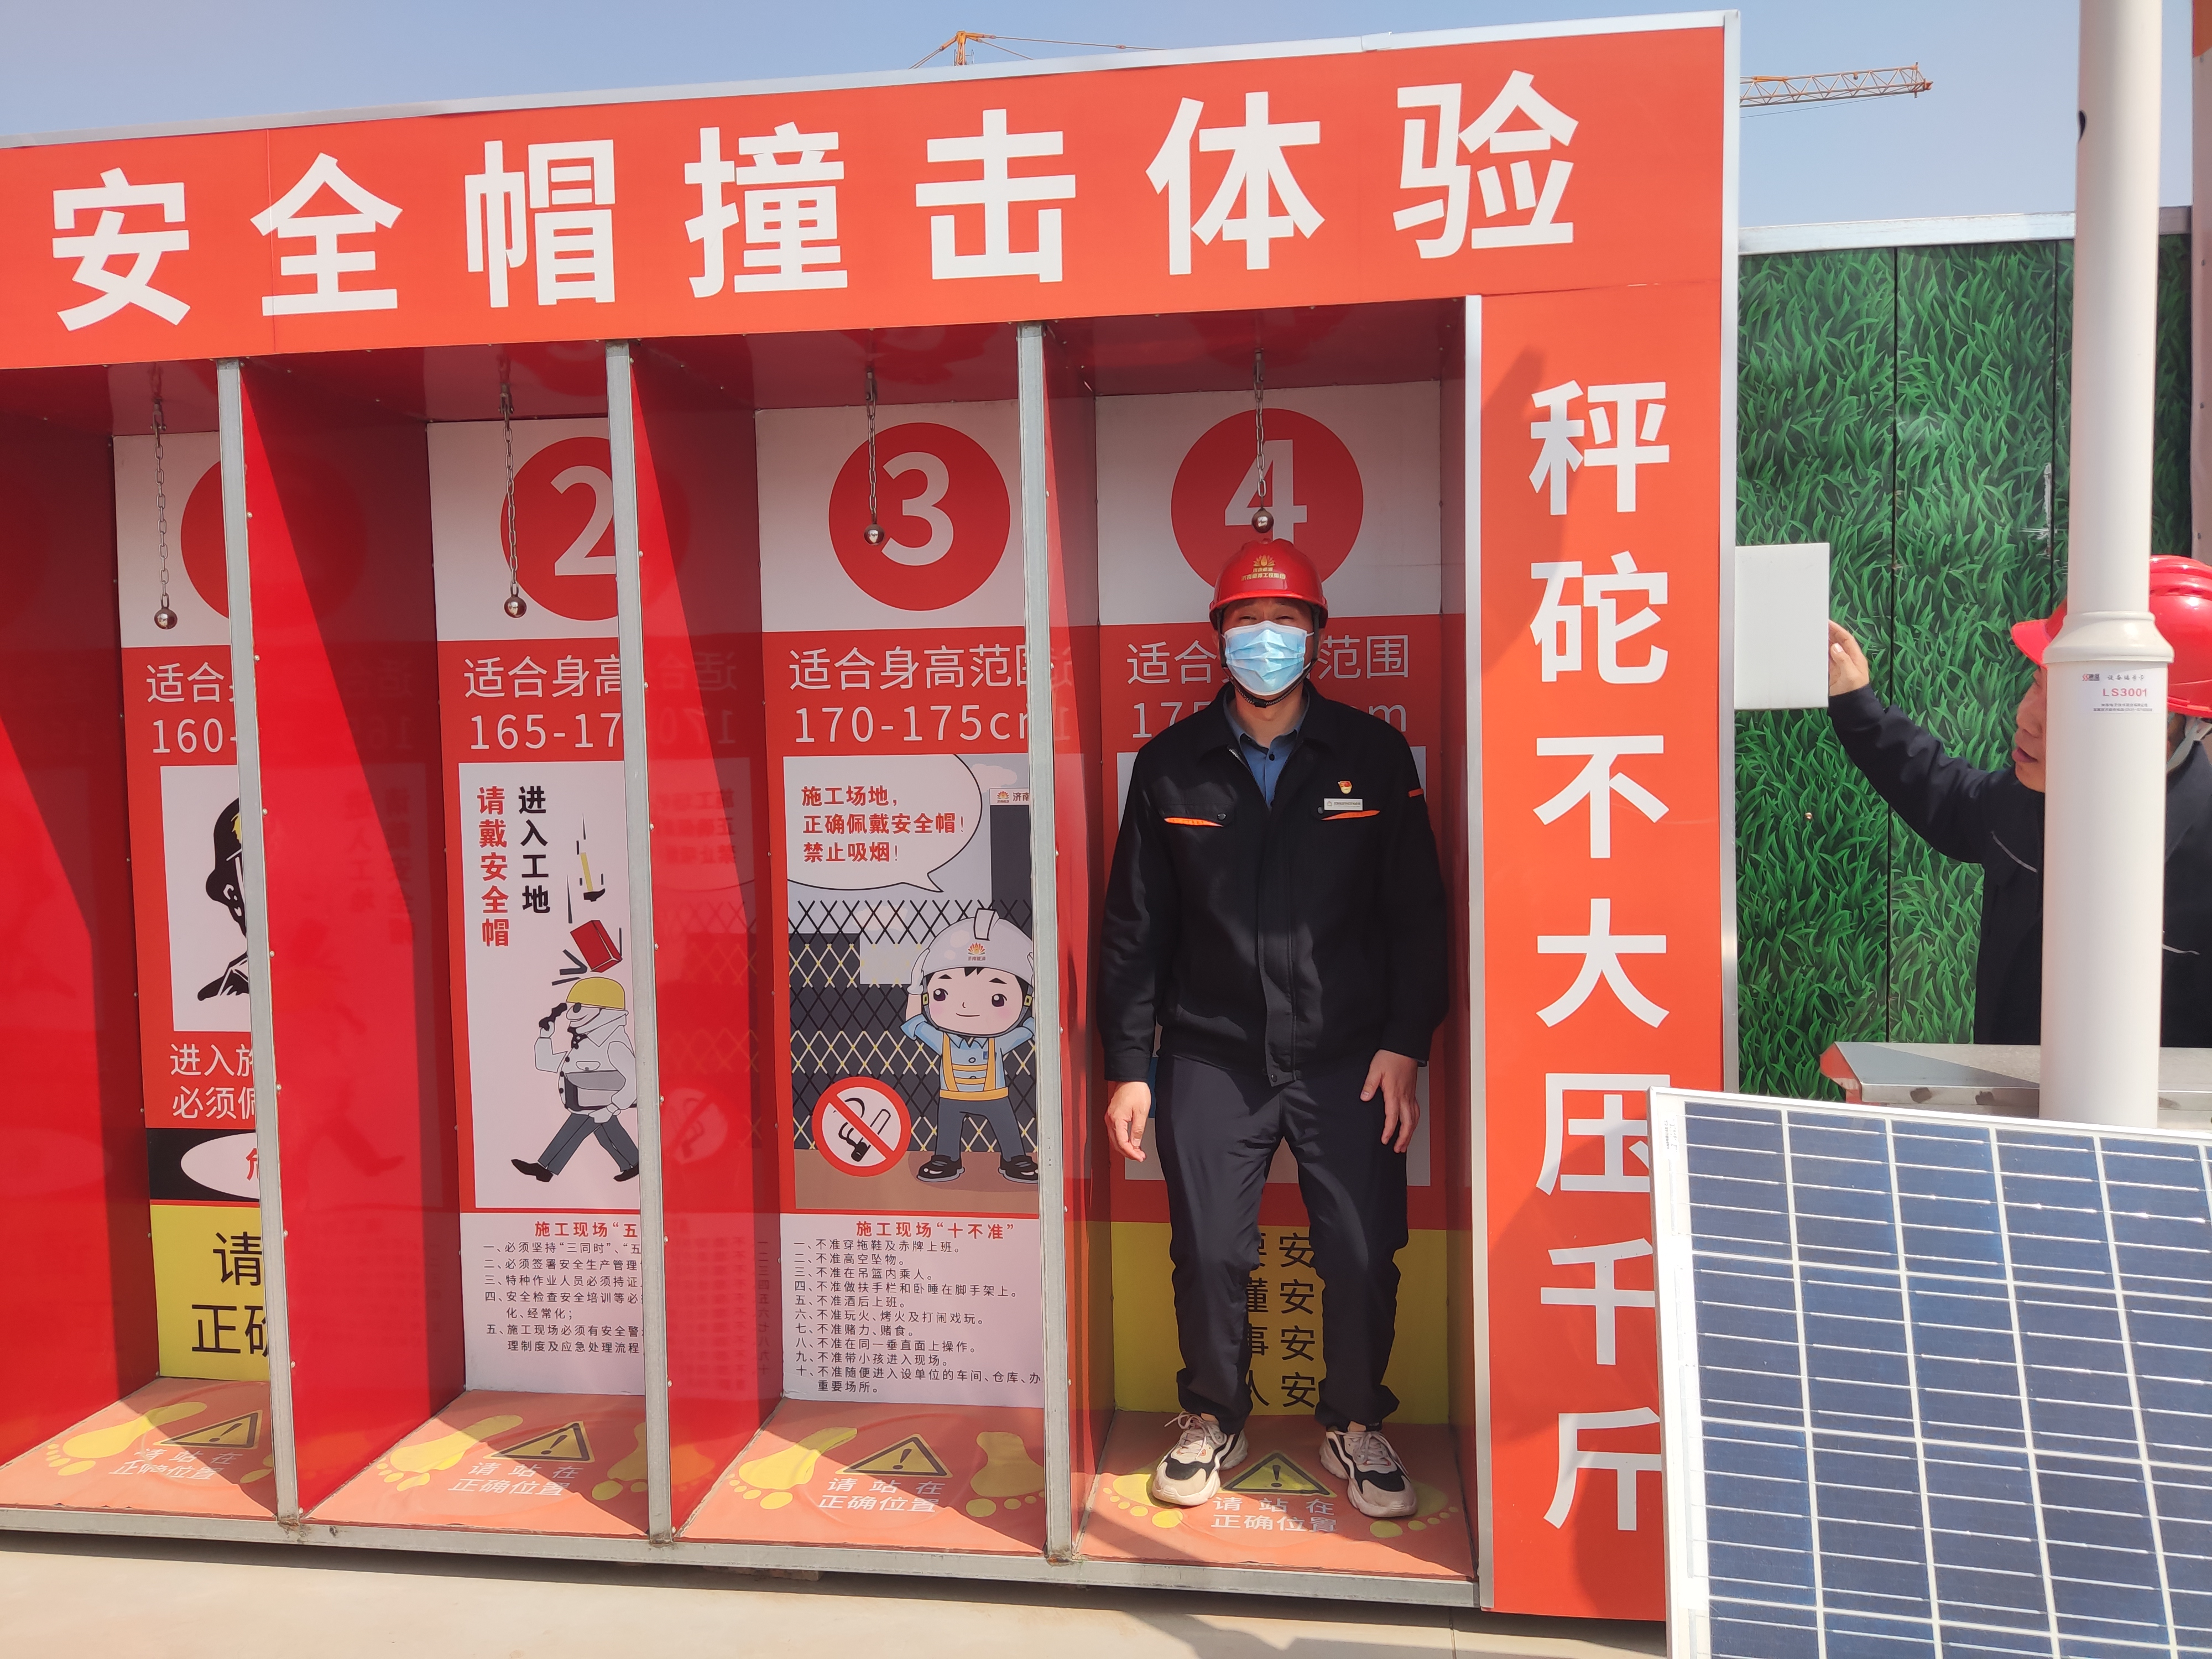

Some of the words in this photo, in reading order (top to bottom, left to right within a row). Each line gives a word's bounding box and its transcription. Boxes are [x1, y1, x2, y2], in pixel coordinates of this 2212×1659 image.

[53, 70, 1578, 331] 安全帽撞击体验
[1225, 439, 1307, 542] 4
[881, 452, 953, 566] 3
[550, 466, 616, 576] 2
[789, 644, 1027, 690] 适合身高范
[1127, 634, 1408, 685] 适合范围
[146, 662, 234, 702] 适合
[464, 654, 620, 698] 适合身高
[2103, 688, 2147, 697] LS3001
[471, 713, 621, 749] 165-17
[801, 785, 898, 807] 施工场地，
[803, 812, 964, 834] 正确佩戴安全帽！
[519, 786, 551, 914] 进入工地
[804, 842, 899, 863] 禁止吸烟！
[477, 786, 509, 947] 请戴安全帽
[1529, 380, 1671, 1531] 秤砣不大压千斤
[856, 1220, 1014, 1239] 施工现场“十不准”
[213, 1231, 262, 1286] 请
[484, 1258, 642, 1271] 二、必须签署安全生产管理
[794, 1253, 904, 1266] 二、不准高空坠物。
[484, 1275, 643, 1287] 三、特种作业人员必须持证
[794, 1267, 932, 1281] 三、不准在吊篮内乘人。
[485, 1291, 643, 1305] 四、安全检查安全培训等必
[795, 1295, 905, 1308] 五、不准酒后上班。
[506, 1307, 572, 1320] 化、经常化；
[795, 1309, 983, 1324] 六、不准玩火、烤火及打闹戏玩。
[487, 1323, 644, 1338] 五、施工现场必须有安全警
[795, 1323, 914, 1337] 七、不准赌力、赌食。
[508, 1340, 640, 1354] 理制度及应急处理流程
[795, 1337, 976, 1353] 八、不准在同一垂直面上操作。
[795, 1351, 948, 1366] 九、不准带小孩进入现场。
[817, 1380, 879, 1394] 重要场所。
[108, 1459, 224, 1480] 正确位置
[448, 1478, 570, 1496] 正确位置
[818, 1494, 940, 1513] 正确位置
[1211, 1514, 1337, 1532] 正确位置
